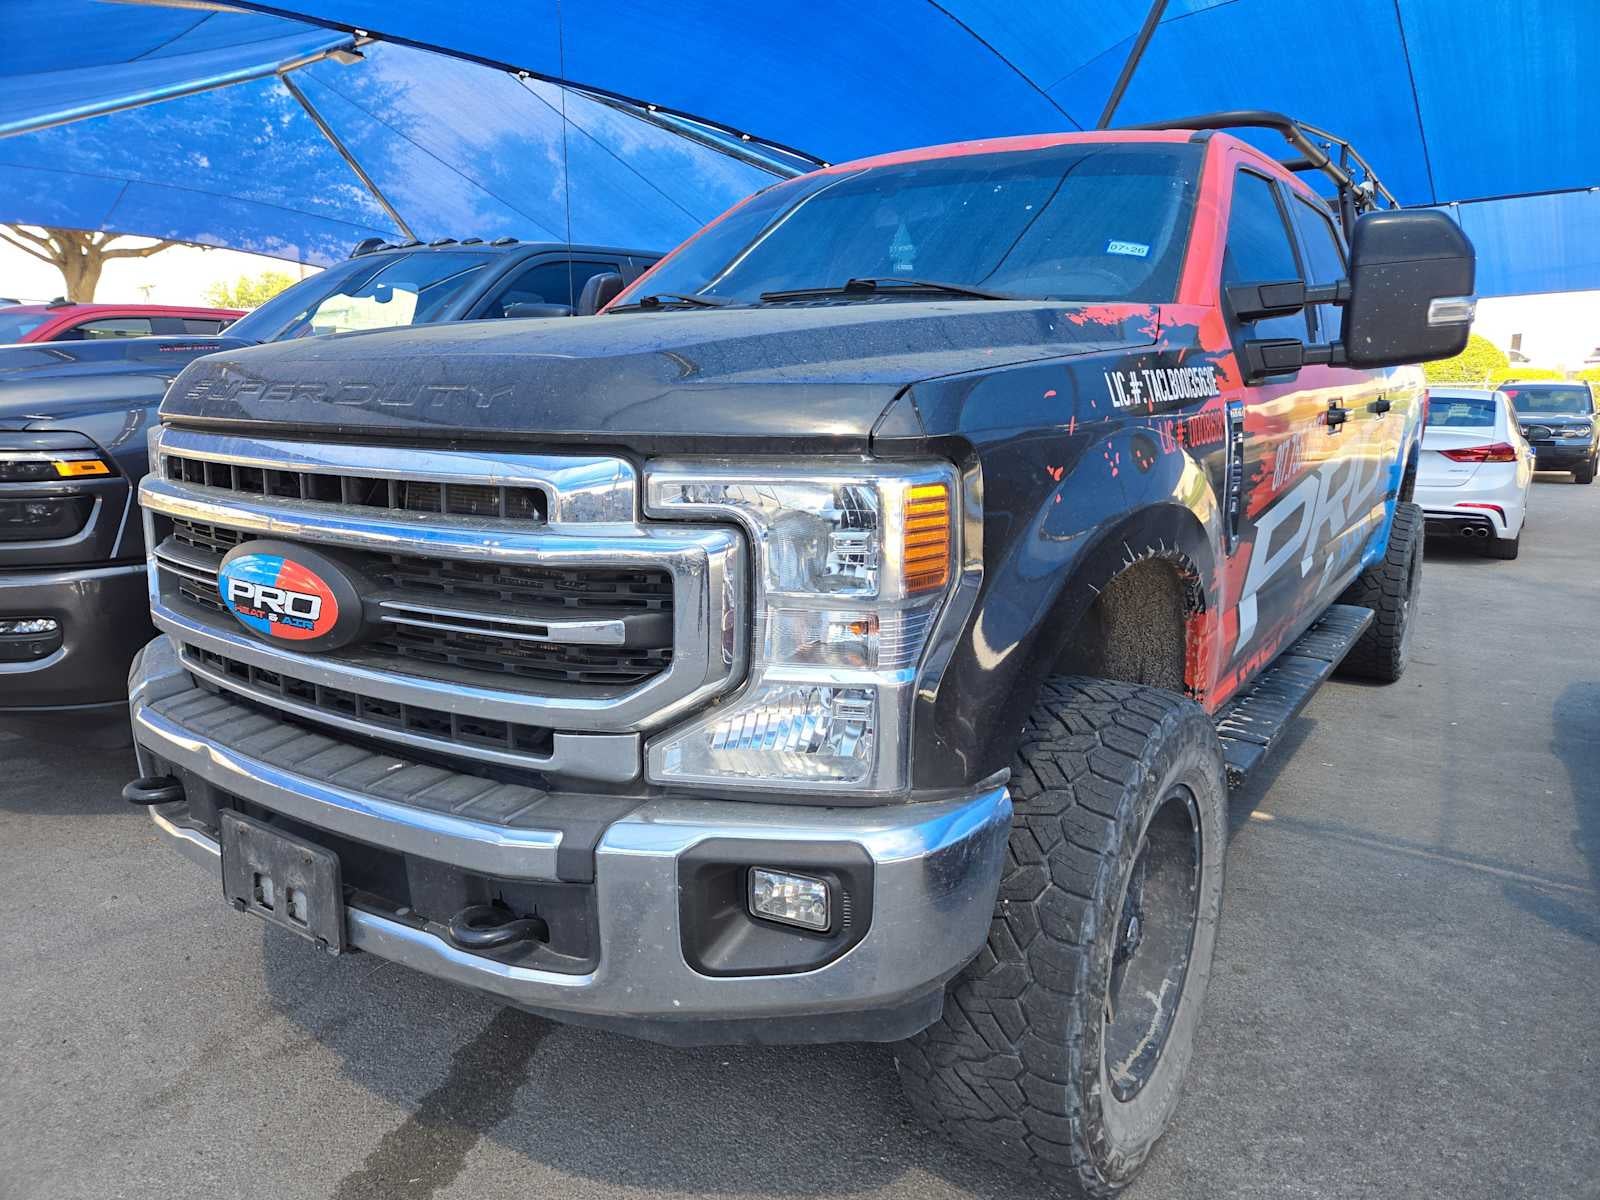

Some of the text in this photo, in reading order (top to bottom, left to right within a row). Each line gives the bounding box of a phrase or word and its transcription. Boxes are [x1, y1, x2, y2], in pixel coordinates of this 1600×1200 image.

[184, 378, 517, 408] SUPER DUTY
[228, 577, 322, 621] PRO
[235, 604, 315, 630] HEAT & AIR
